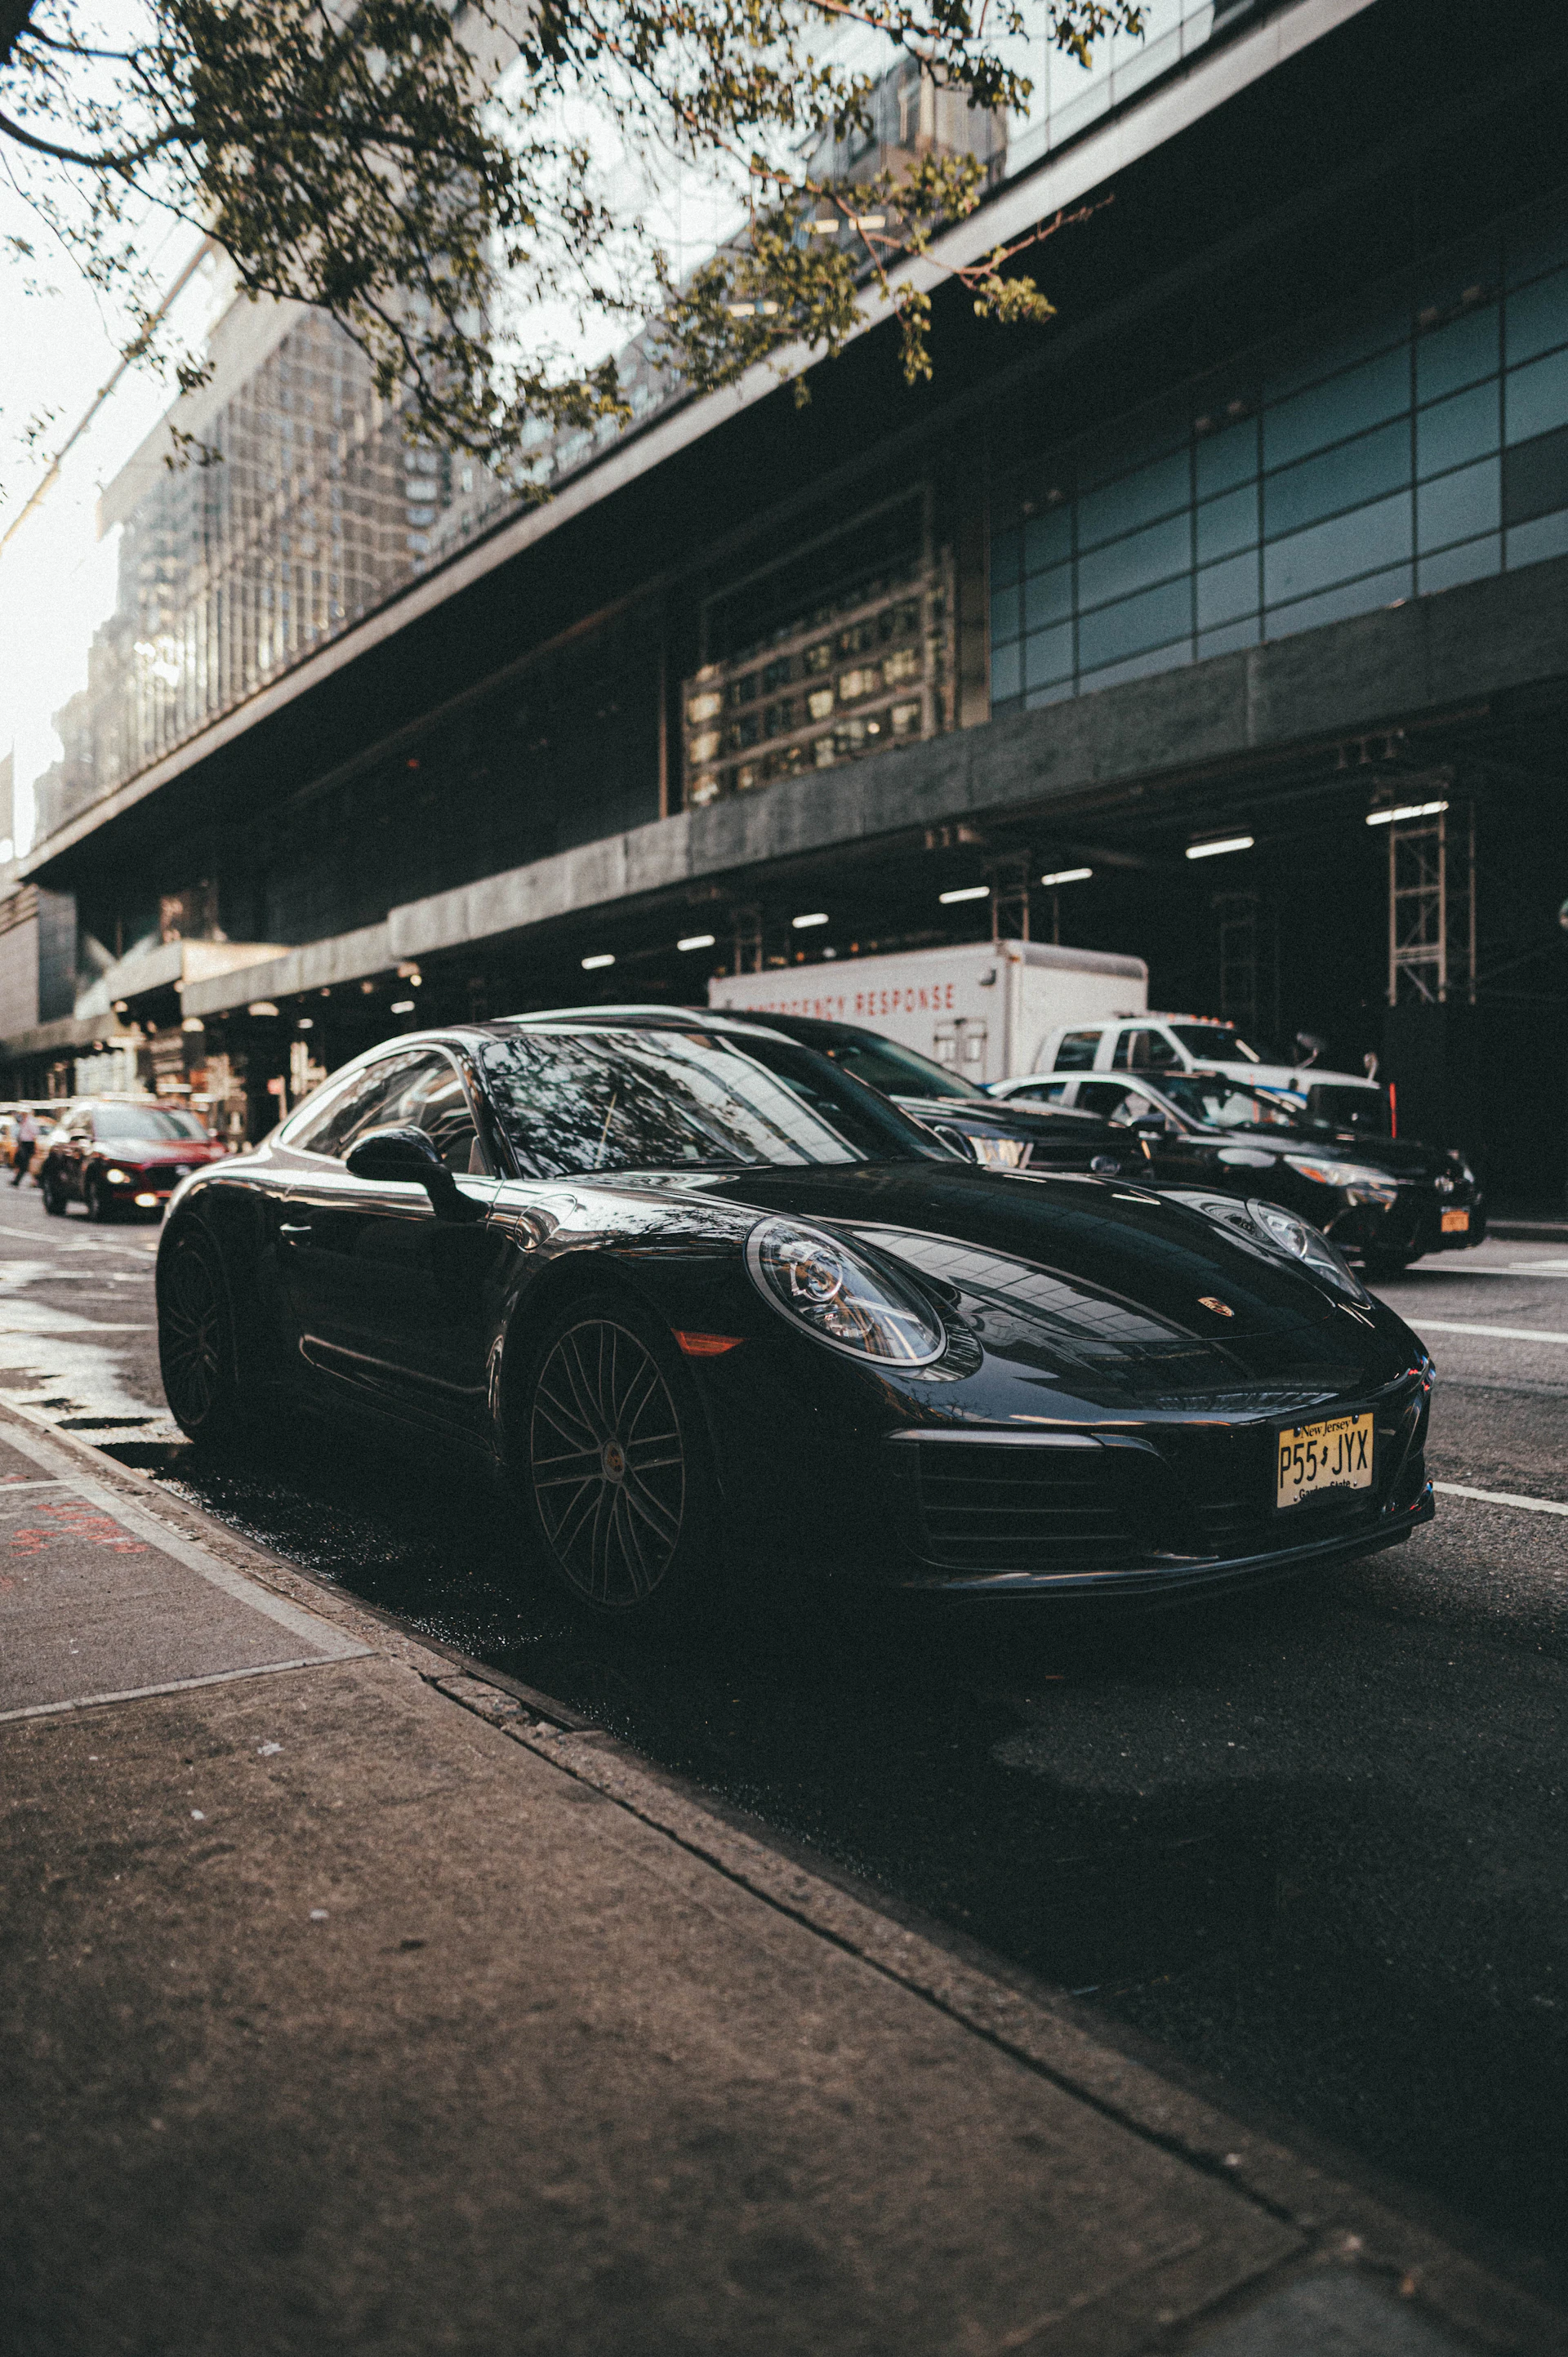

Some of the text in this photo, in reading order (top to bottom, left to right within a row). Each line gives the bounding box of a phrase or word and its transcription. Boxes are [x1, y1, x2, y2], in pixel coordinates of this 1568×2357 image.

[854, 983, 954, 1016] RESPONSE
[1301, 1419, 1351, 1438] New Jersey
[1280, 1429, 1368, 1489] P55 JYX
